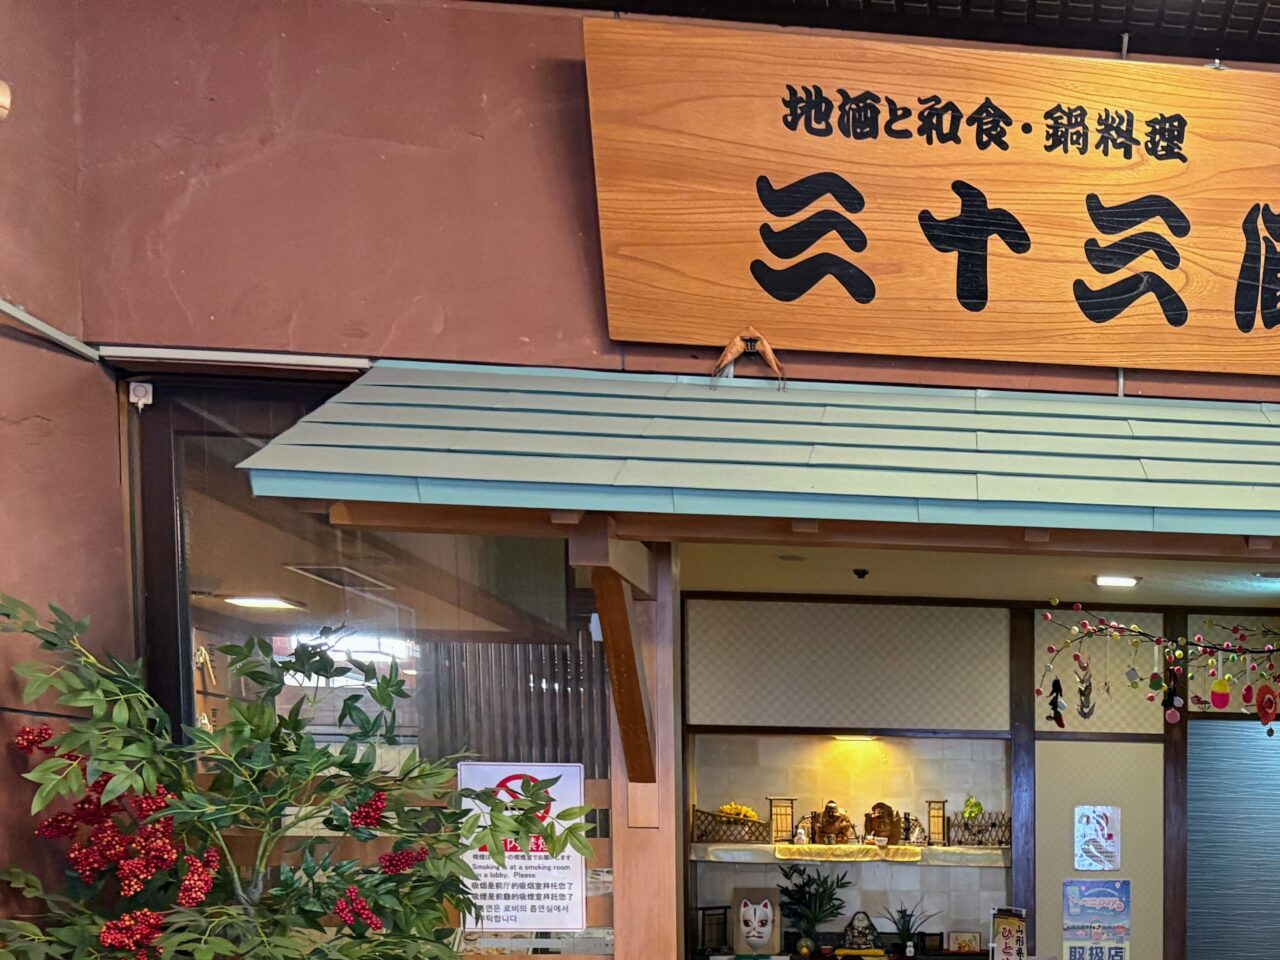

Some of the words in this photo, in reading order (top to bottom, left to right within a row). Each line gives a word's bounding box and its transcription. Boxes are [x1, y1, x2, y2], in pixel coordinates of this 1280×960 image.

[781, 83, 1188, 164] 地酒と和食・鍋料理
